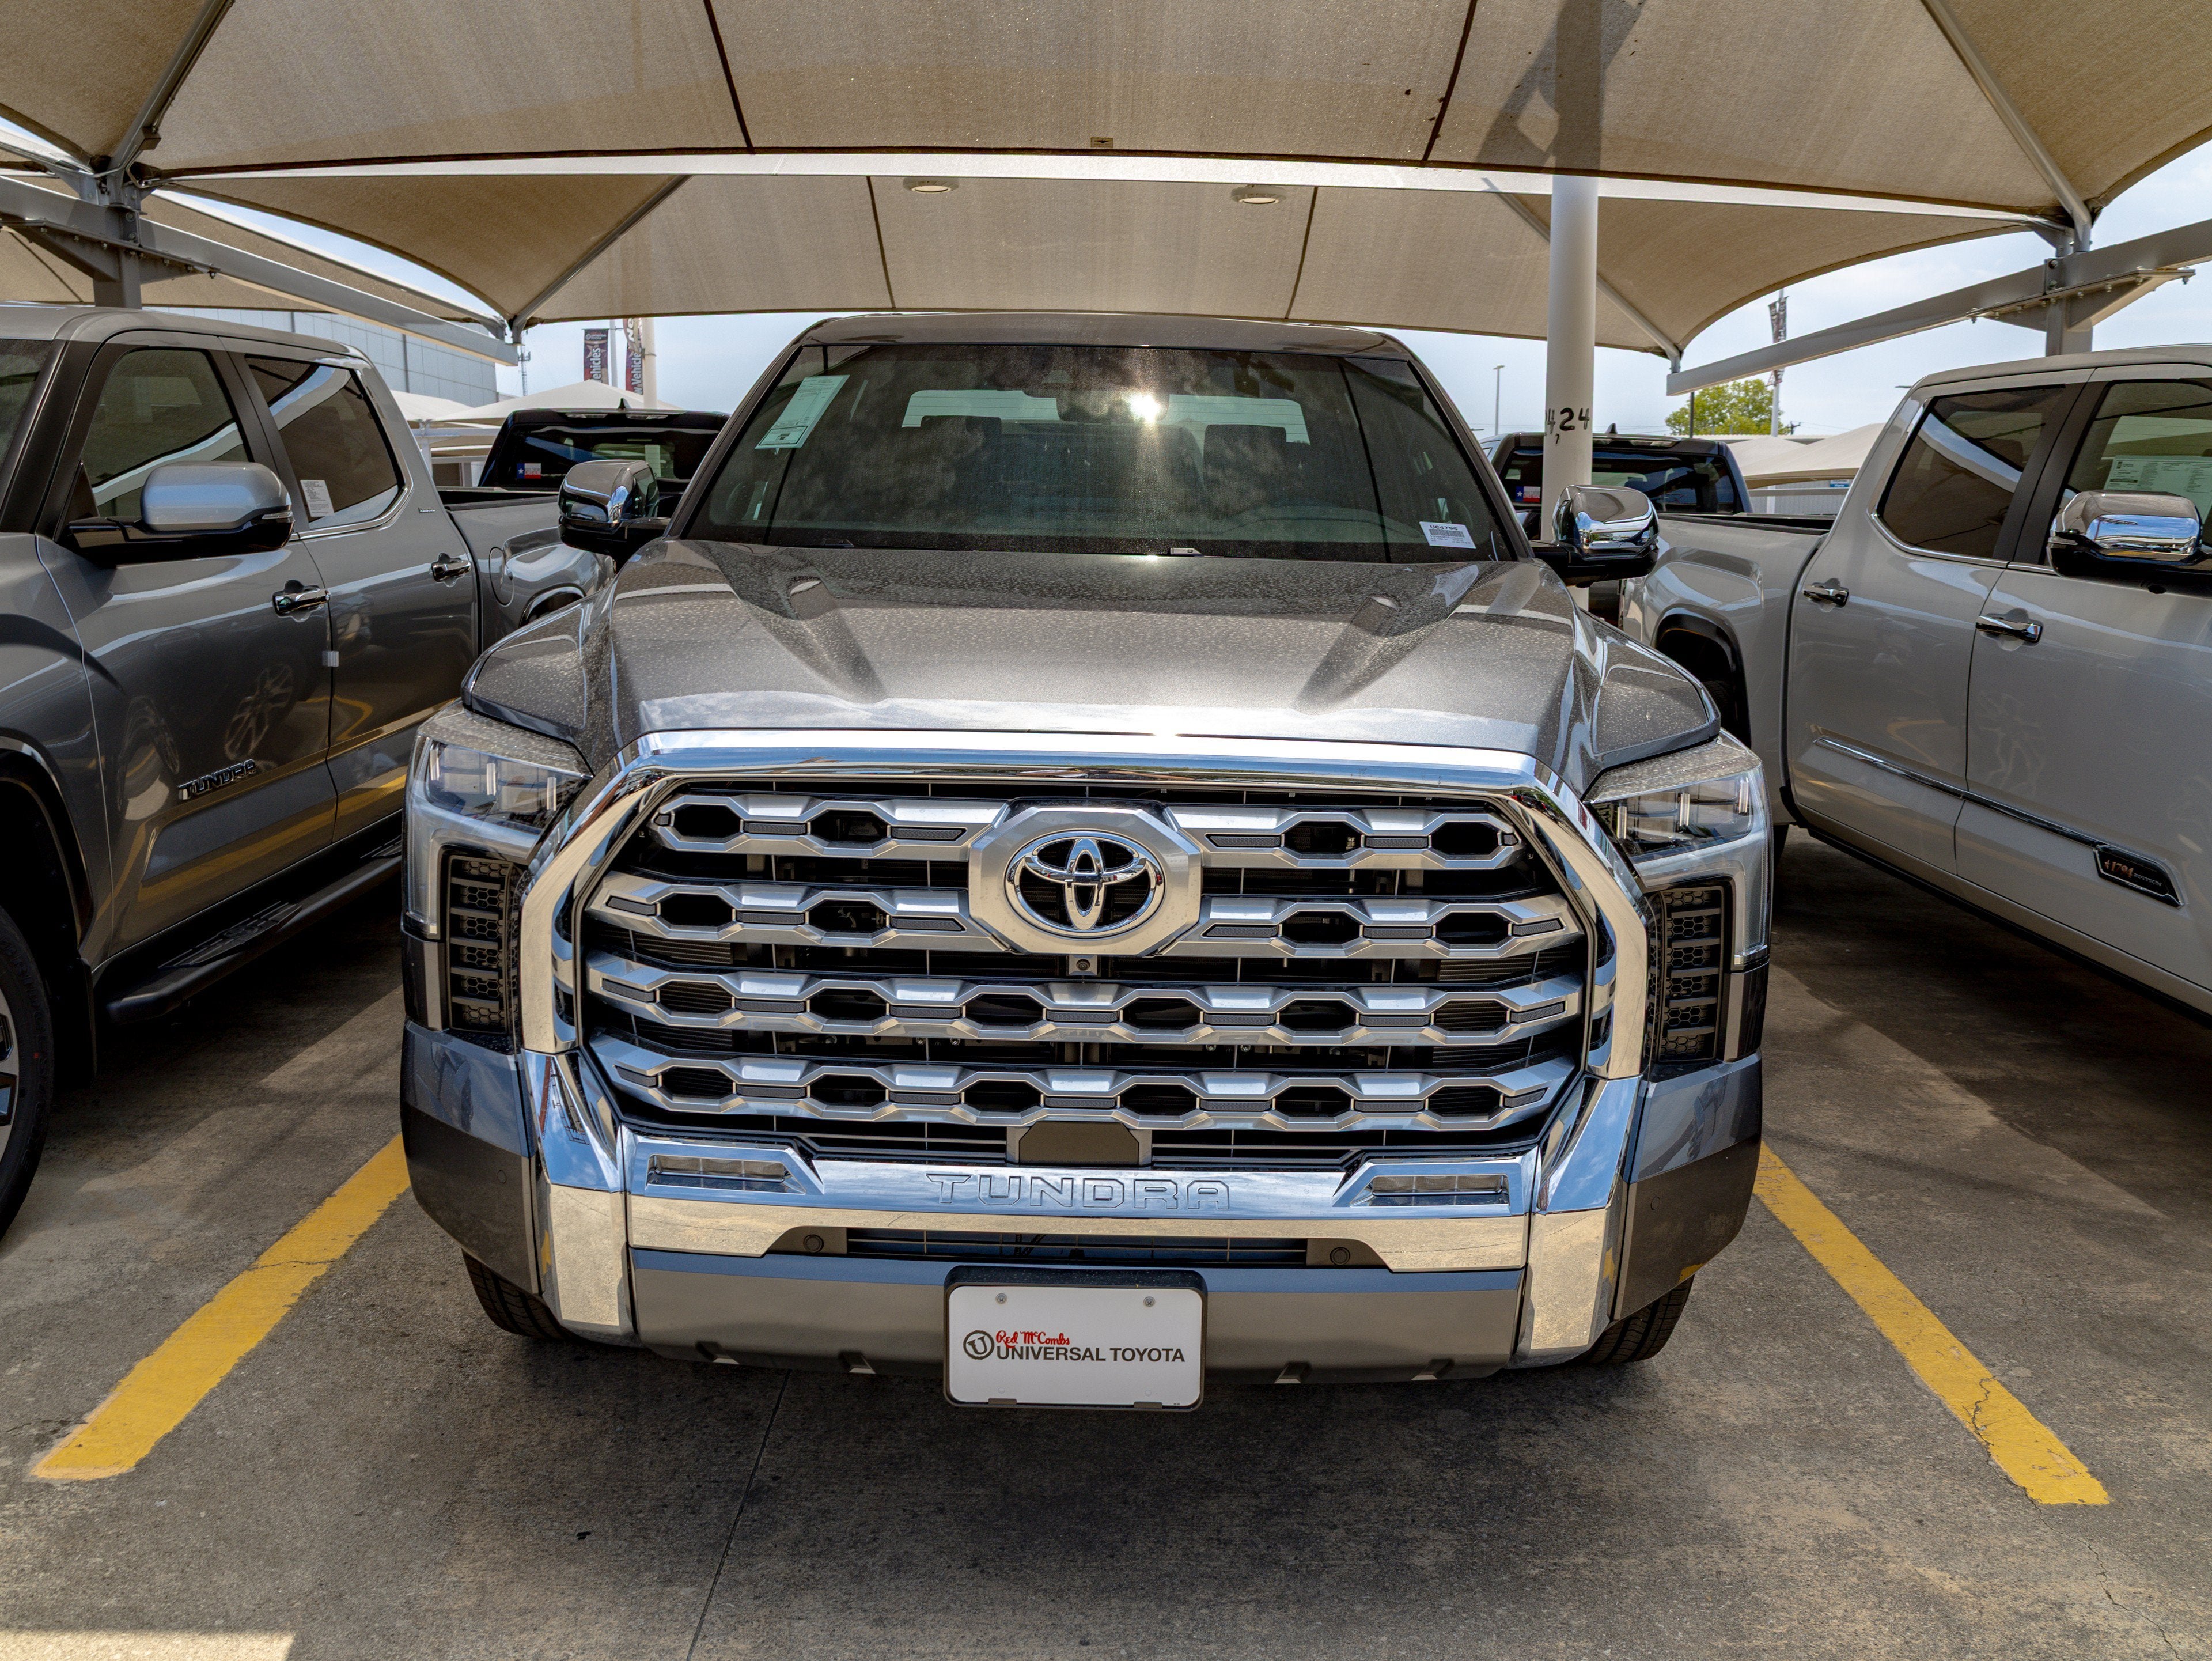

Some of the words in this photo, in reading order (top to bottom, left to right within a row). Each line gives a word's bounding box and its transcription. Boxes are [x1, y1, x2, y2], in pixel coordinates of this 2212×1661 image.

[631, 348, 642, 385] Vehicle
[1559, 407, 1589, 431] 24
[178, 758, 257, 800] TUNDRA
[2111, 861, 2134, 879] 1794
[925, 1173, 1230, 1210] TUNDRA
[996, 1330, 1018, 1349] Red
[1020, 1331, 1070, 1346] McCombs
[997, 1345, 1106, 1361] UNIVERSAL
[1109, 1347, 1185, 1363] TOYOTA
